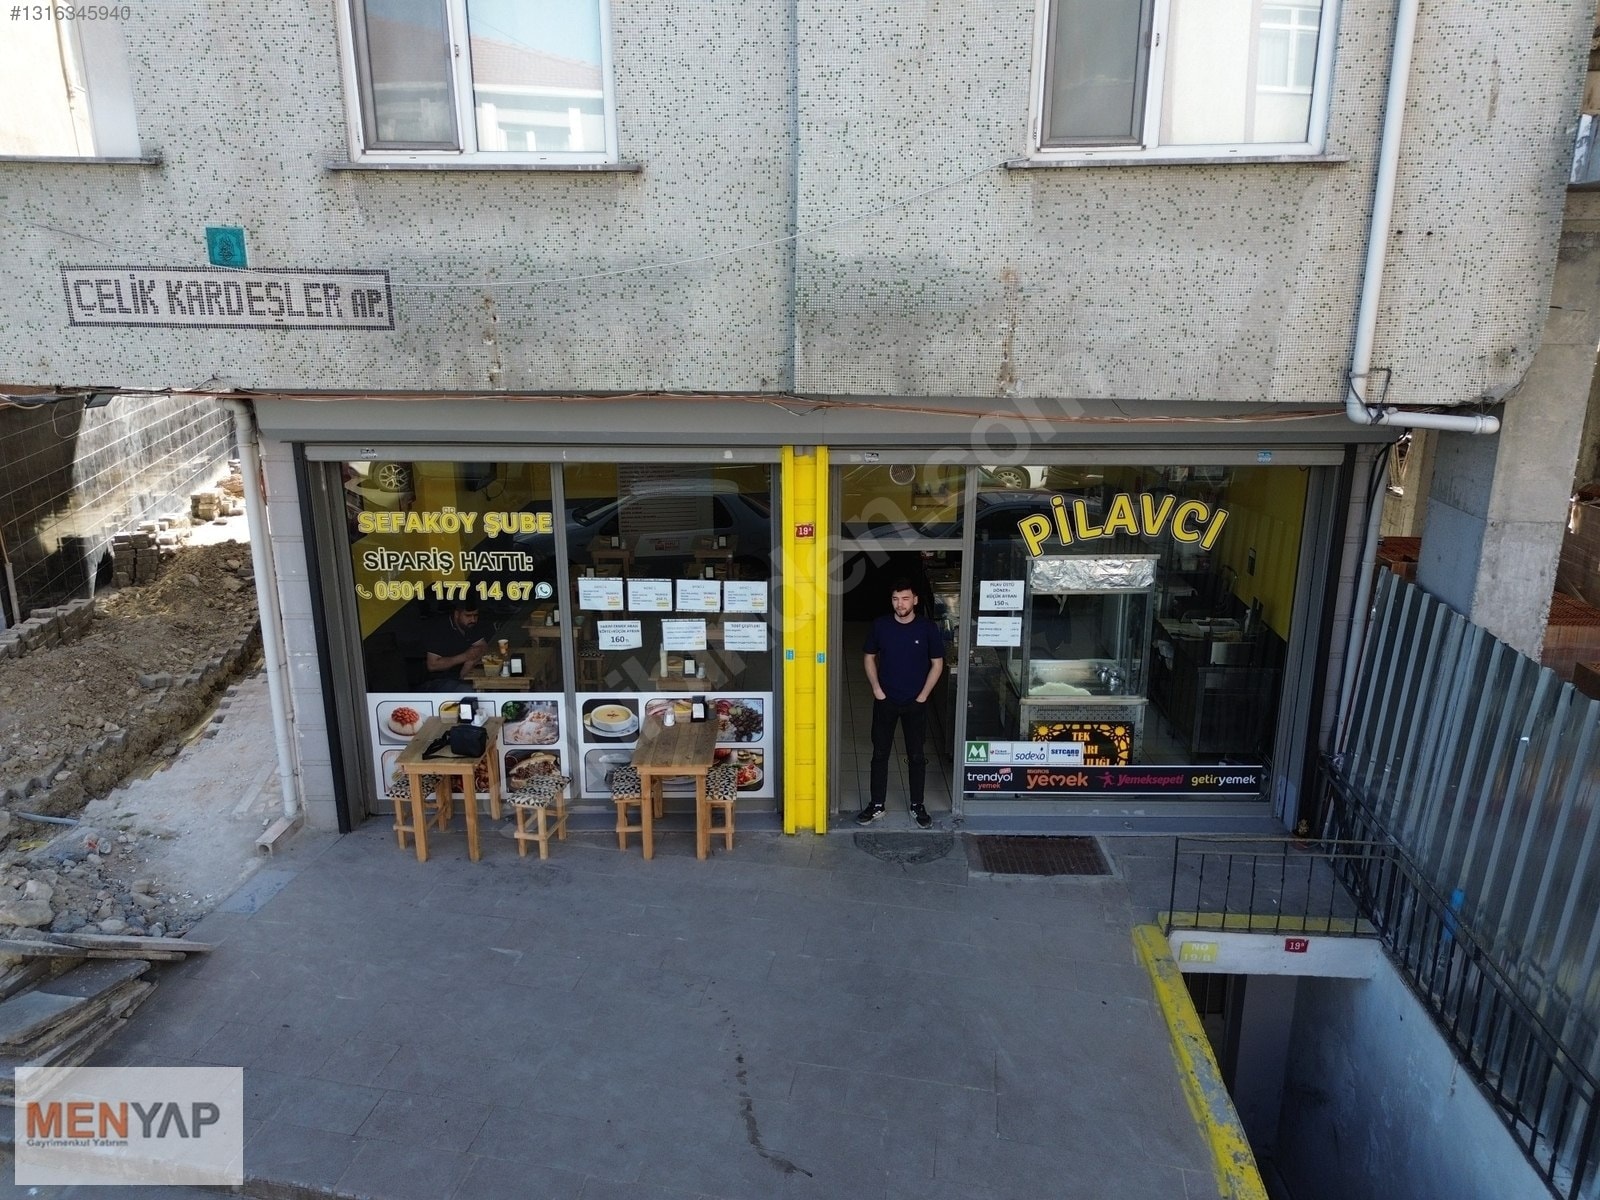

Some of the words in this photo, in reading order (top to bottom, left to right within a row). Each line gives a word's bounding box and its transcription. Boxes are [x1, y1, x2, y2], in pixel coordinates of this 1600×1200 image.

[165, 279, 344, 323] KARDEŞLER
[357, 506, 478, 534] SEFAKÖY
[484, 511, 554, 539] ŞUBE
[1017, 492, 1230, 559] PİLAVCI
[363, 546, 455, 575] SİPARİŞ
[459, 550, 535, 572] HATTI:
[374, 580, 425, 601] 0501
[431, 580, 471, 601] 177
[475, 580, 504, 601] 14
[506, 580, 534, 601] 67
[610, 635, 625, 643] 160
[1072, 731, 1090, 742] TEK
[1015, 751, 1046, 760] sodexo
[1084, 744, 1099, 755] ARI
[967, 772, 1013, 783] trendyol
[1026, 772, 1089, 789] yemek
[978, 782, 1001, 790] yemek
